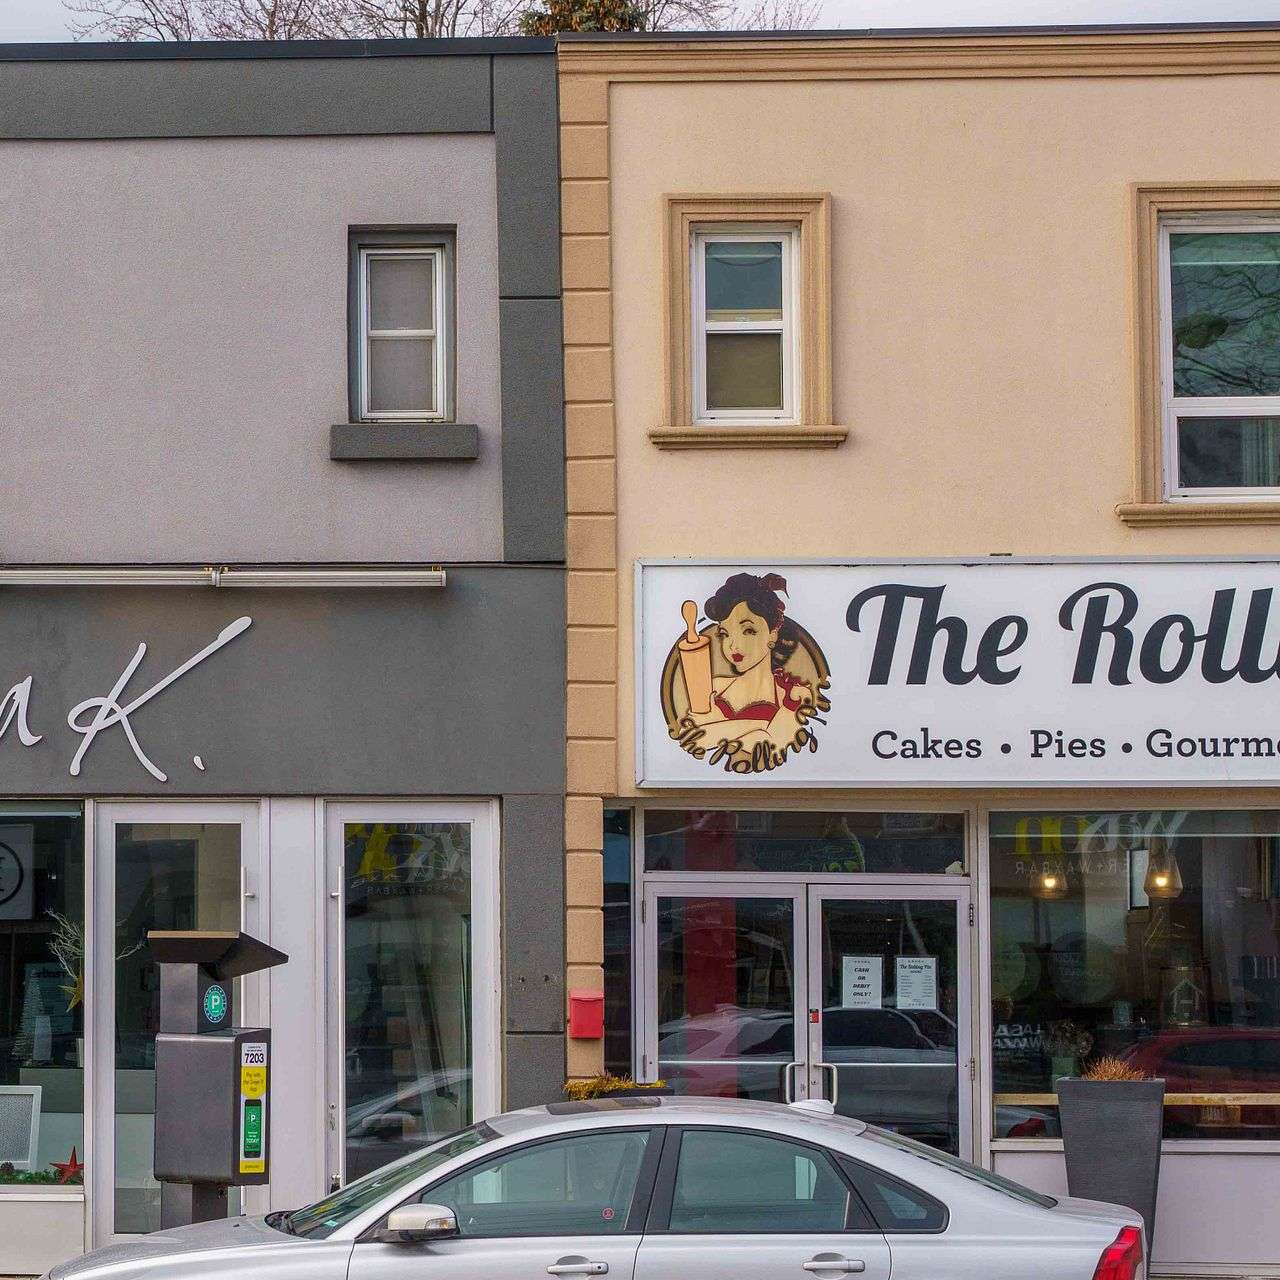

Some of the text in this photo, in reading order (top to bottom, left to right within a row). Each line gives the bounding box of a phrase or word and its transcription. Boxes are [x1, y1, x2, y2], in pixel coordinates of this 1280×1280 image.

[845, 581, 1280, 686] The Roll
[871, 727, 1280, 760] Cakes Pies Gourm
[244, 1053, 264, 1064] 7203
